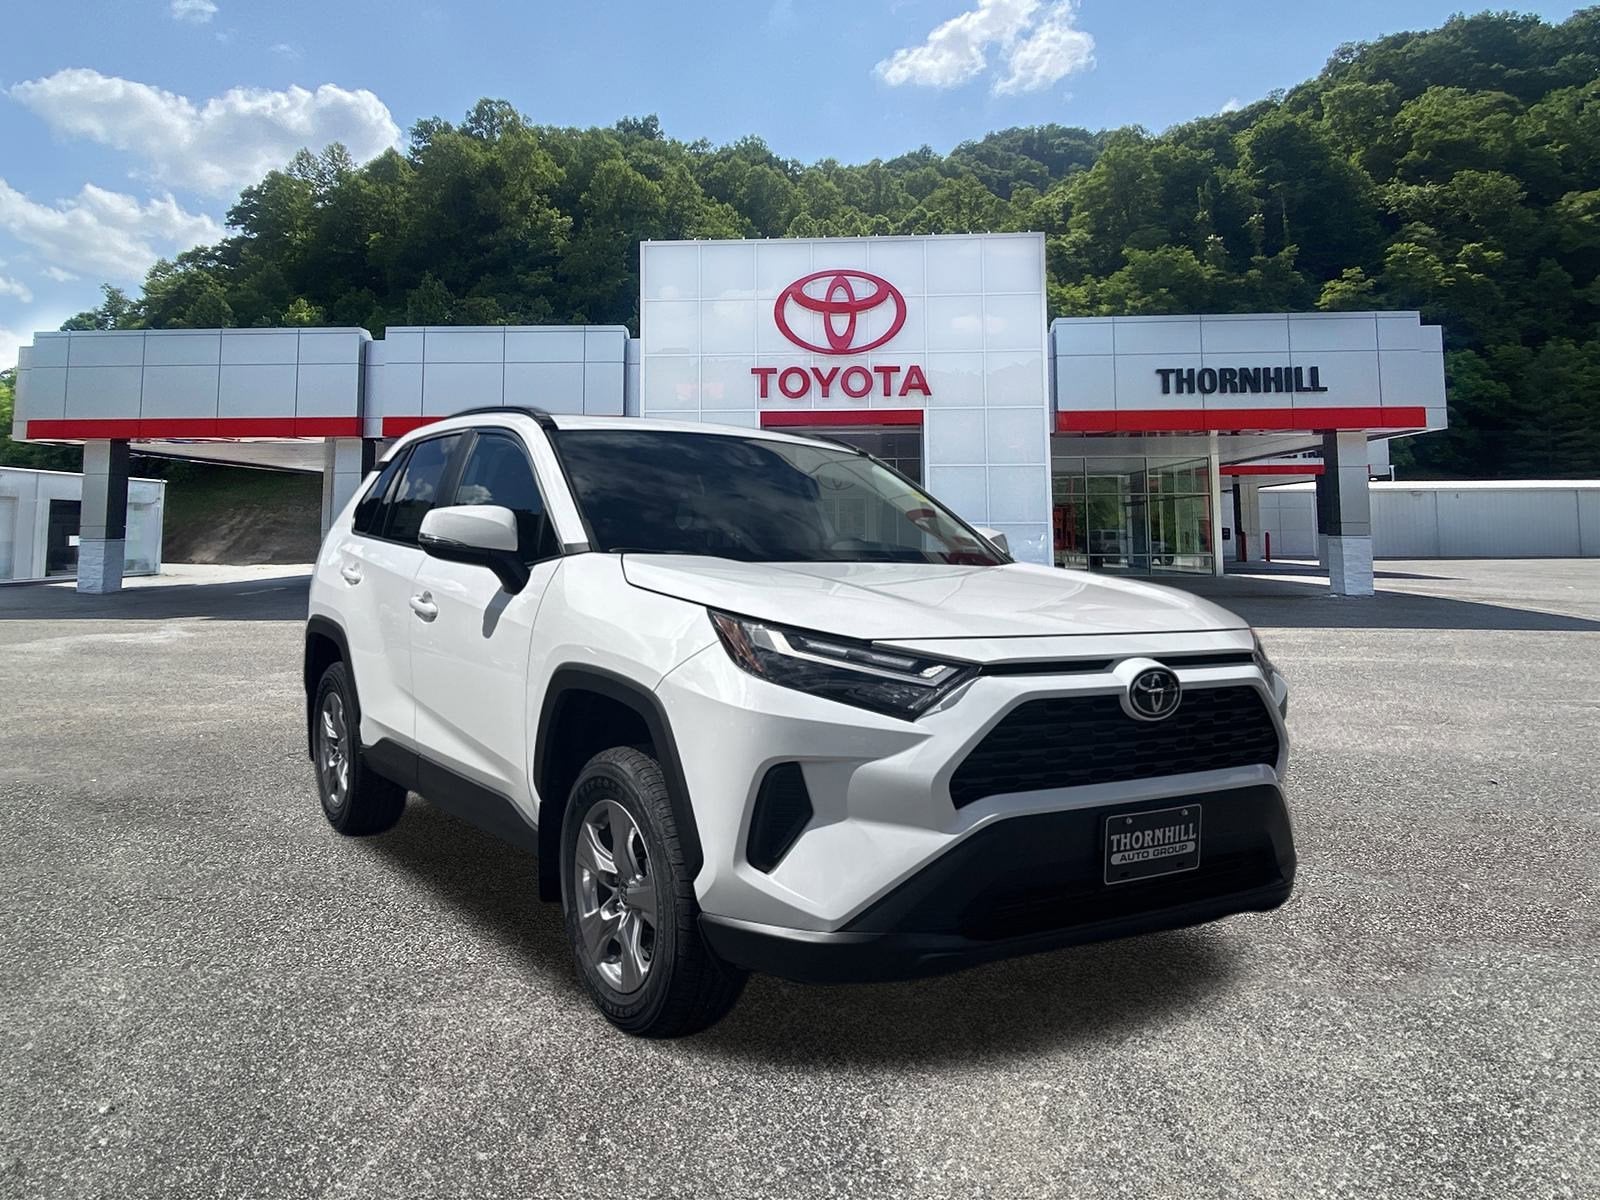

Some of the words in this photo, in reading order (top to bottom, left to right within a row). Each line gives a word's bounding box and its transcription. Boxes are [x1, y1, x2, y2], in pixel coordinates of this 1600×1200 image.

[751, 366, 932, 399] TOYOTA
[1156, 366, 1328, 394] THORNHILL
[1110, 823, 1197, 852] THORNHILL
[1120, 850, 1150, 862] AUTO
[1152, 844, 1188, 857] GROUP
